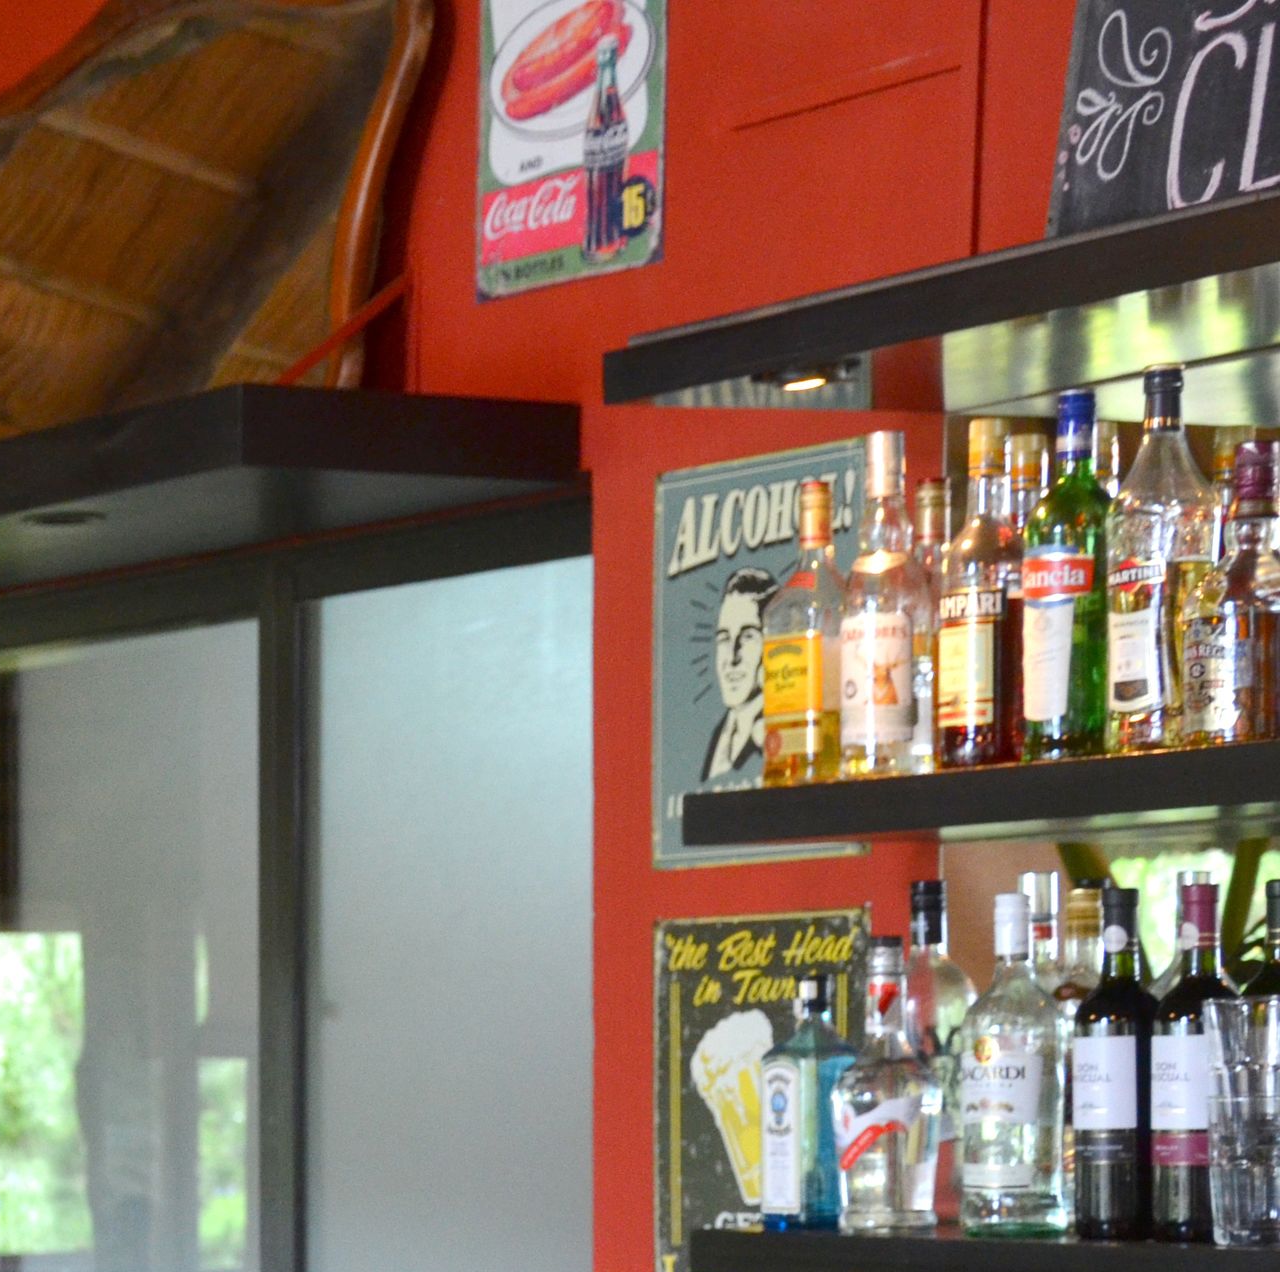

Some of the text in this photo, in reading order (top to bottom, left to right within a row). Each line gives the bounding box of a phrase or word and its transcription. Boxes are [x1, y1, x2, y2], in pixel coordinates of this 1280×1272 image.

[667, 469, 856, 577] ALCOHL!
[718, 929, 776, 971] Best
[782, 925, 859, 967] Head
